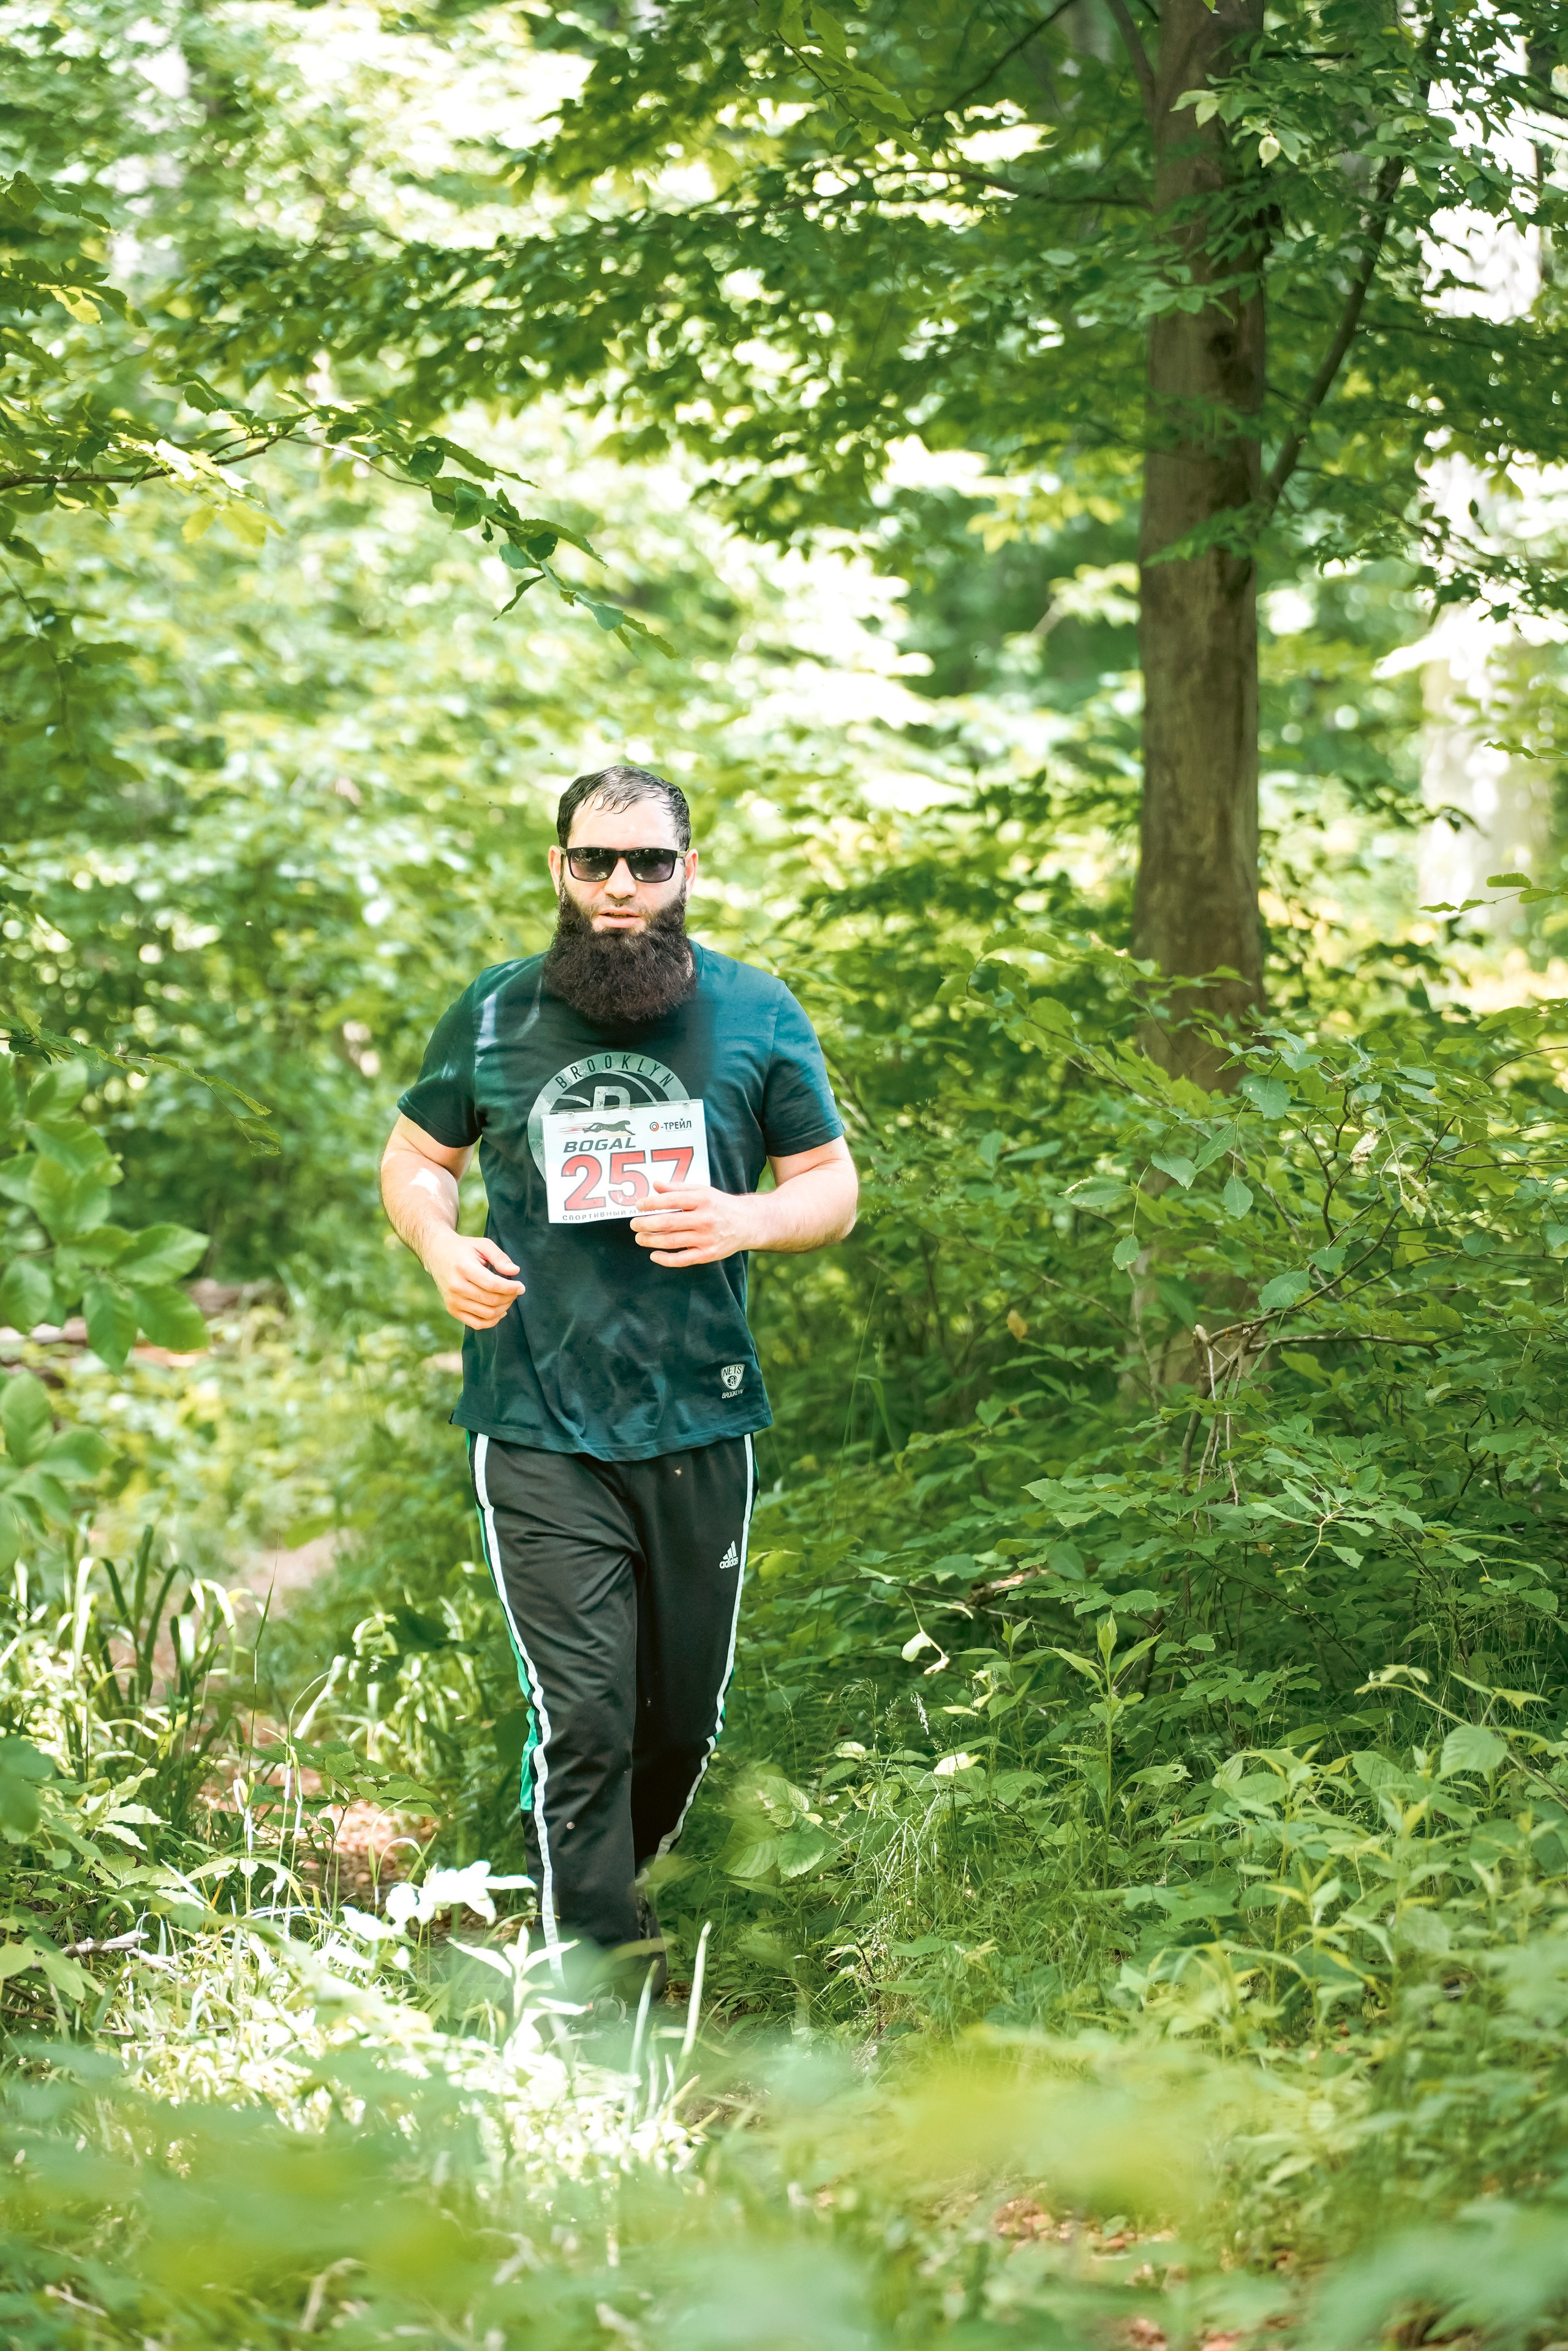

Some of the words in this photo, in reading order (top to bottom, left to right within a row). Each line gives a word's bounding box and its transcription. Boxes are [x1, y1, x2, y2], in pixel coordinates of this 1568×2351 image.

[554, 1054, 675, 1089] BROOKLYN
[563, 1137, 636, 1153] BOGAL
[560, 1145, 695, 1211] 257
[562, 1210, 627, 1220] СПОРТИВНЫЙ
[723, 1365, 742, 1377] NETS
[722, 1389, 744, 1399] BROOKLYN
[719, 1557, 739, 1569] adidas
